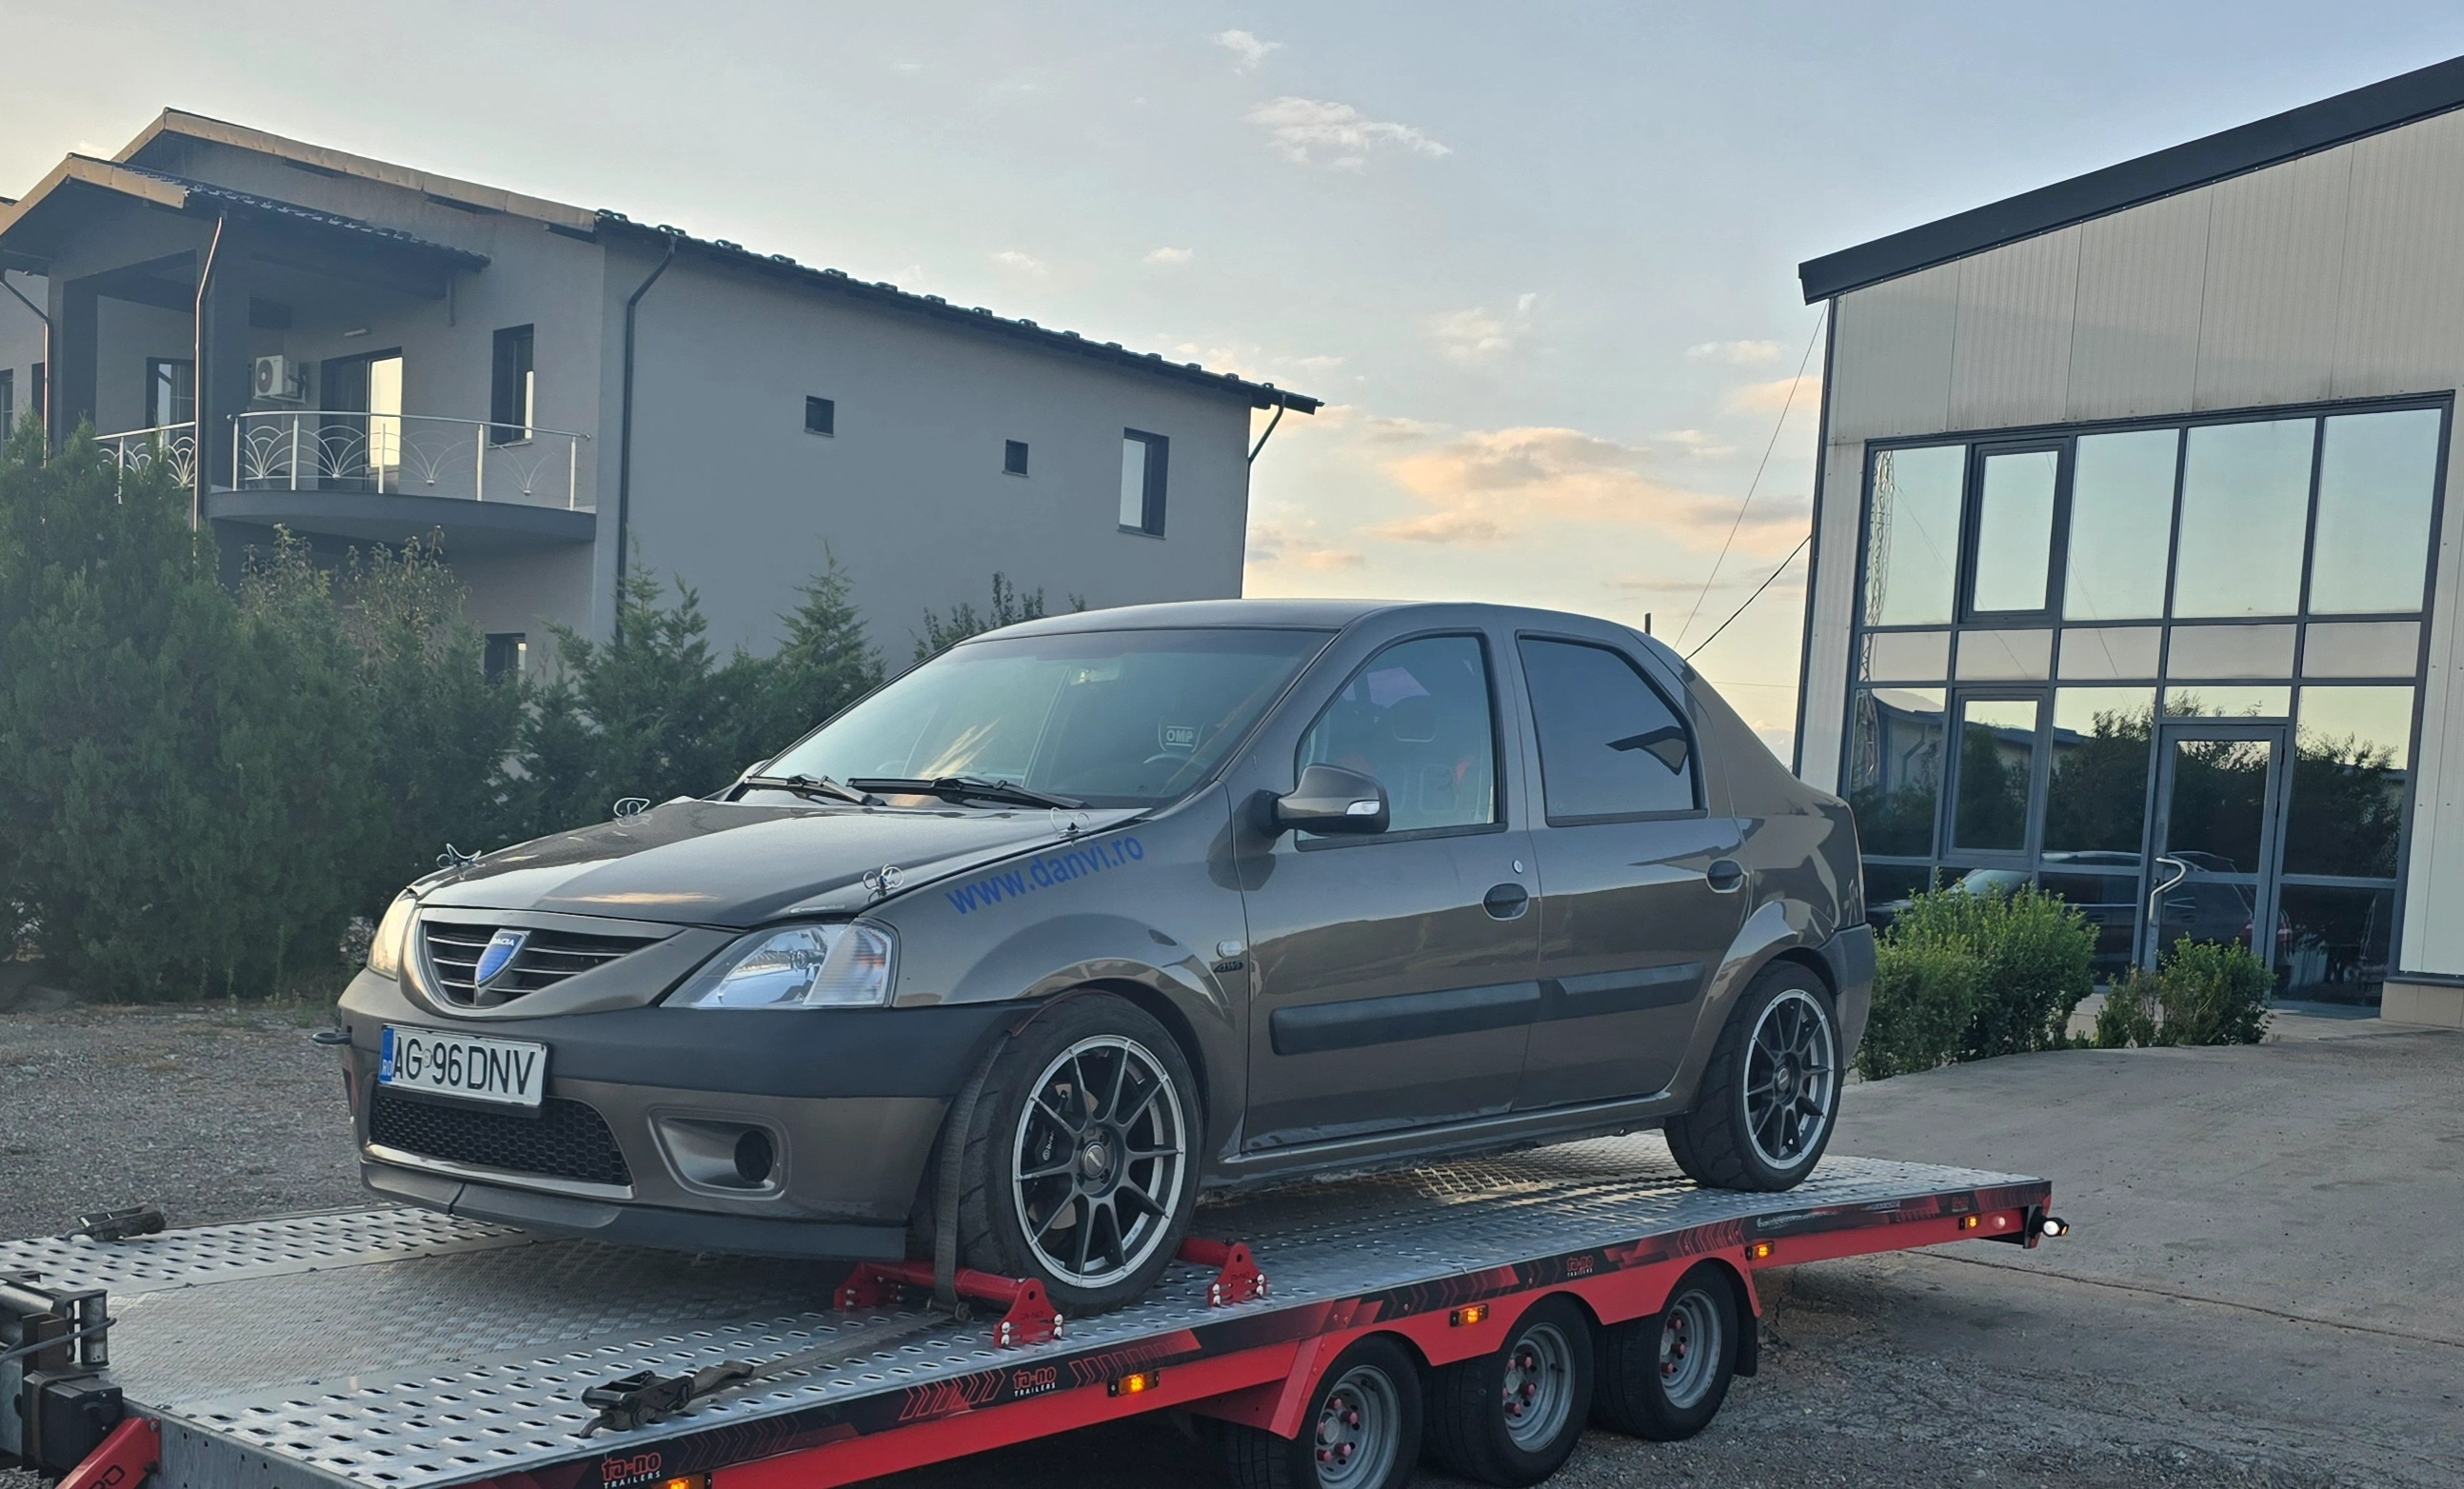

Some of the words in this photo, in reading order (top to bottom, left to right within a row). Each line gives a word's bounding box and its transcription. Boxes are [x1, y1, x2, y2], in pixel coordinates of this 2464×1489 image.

[1166, 729, 1194, 743] OMP
[944, 836, 1144, 915] www.danvi.ro
[1014, 1381, 1056, 1398] TRAILERS
[604, 1471, 661, 1489] TRAILERS
